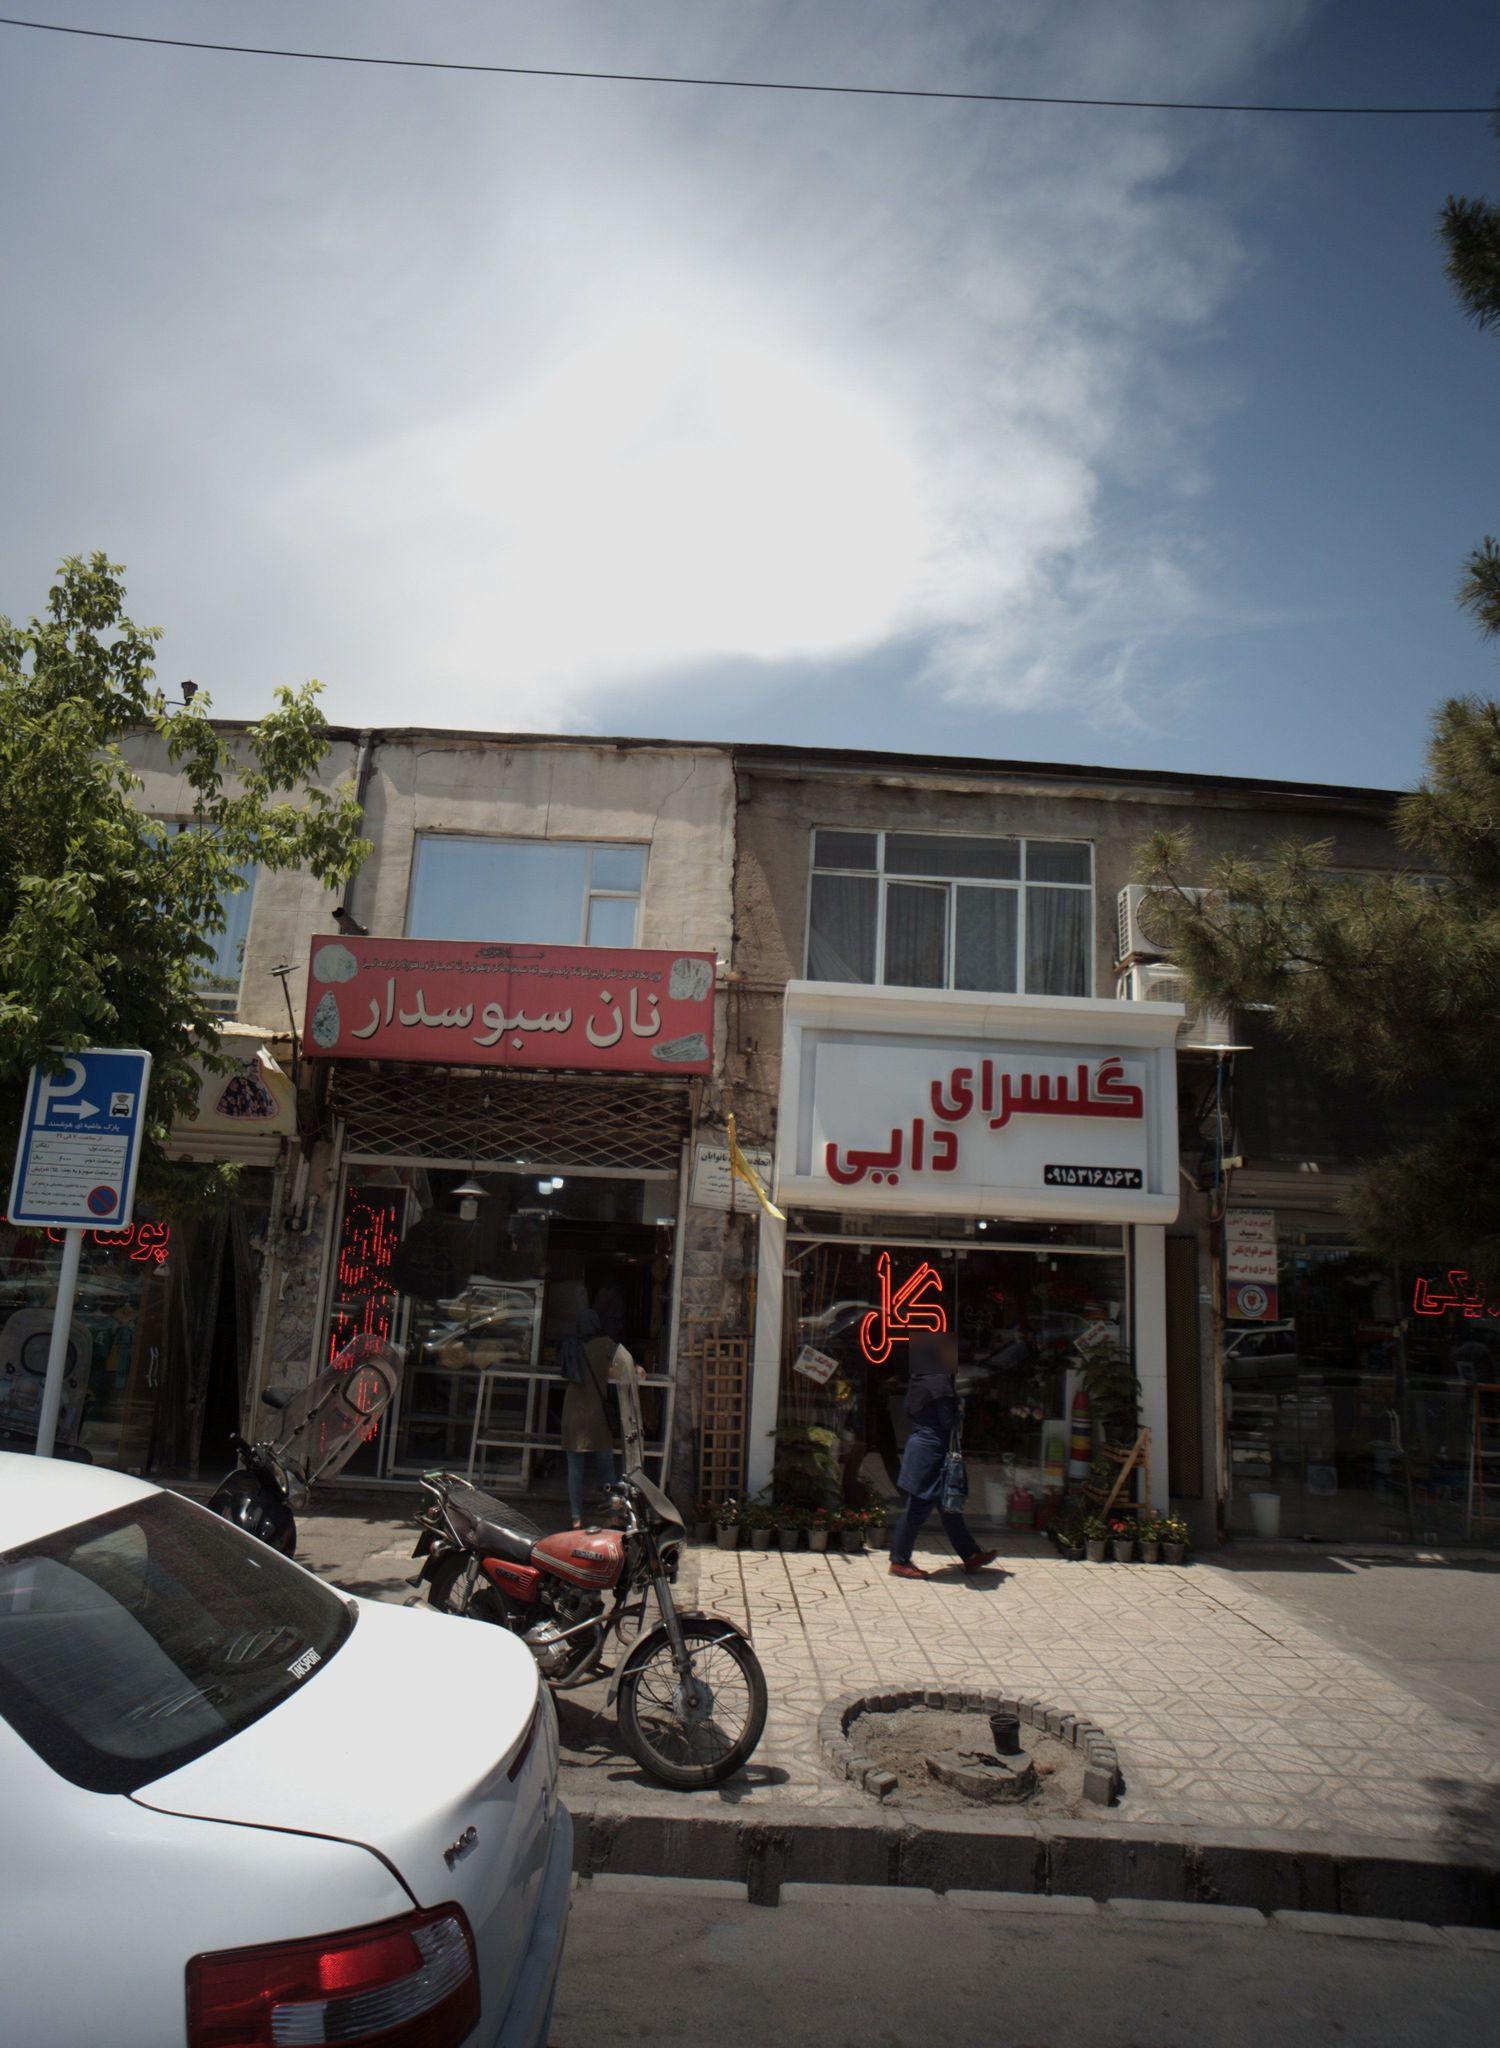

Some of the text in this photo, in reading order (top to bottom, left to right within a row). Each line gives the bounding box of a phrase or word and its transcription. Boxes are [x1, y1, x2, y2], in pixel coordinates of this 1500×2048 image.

[585, 987, 661, 1048] نان
[930, 1056, 1144, 1130] گلسرای
[826, 1117, 958, 1185] دایی
[47, 1220, 171, 1264] پوش
[861, 1252, 947, 1364] گل
[286, 1646, 323, 1680] TAKSPORT
